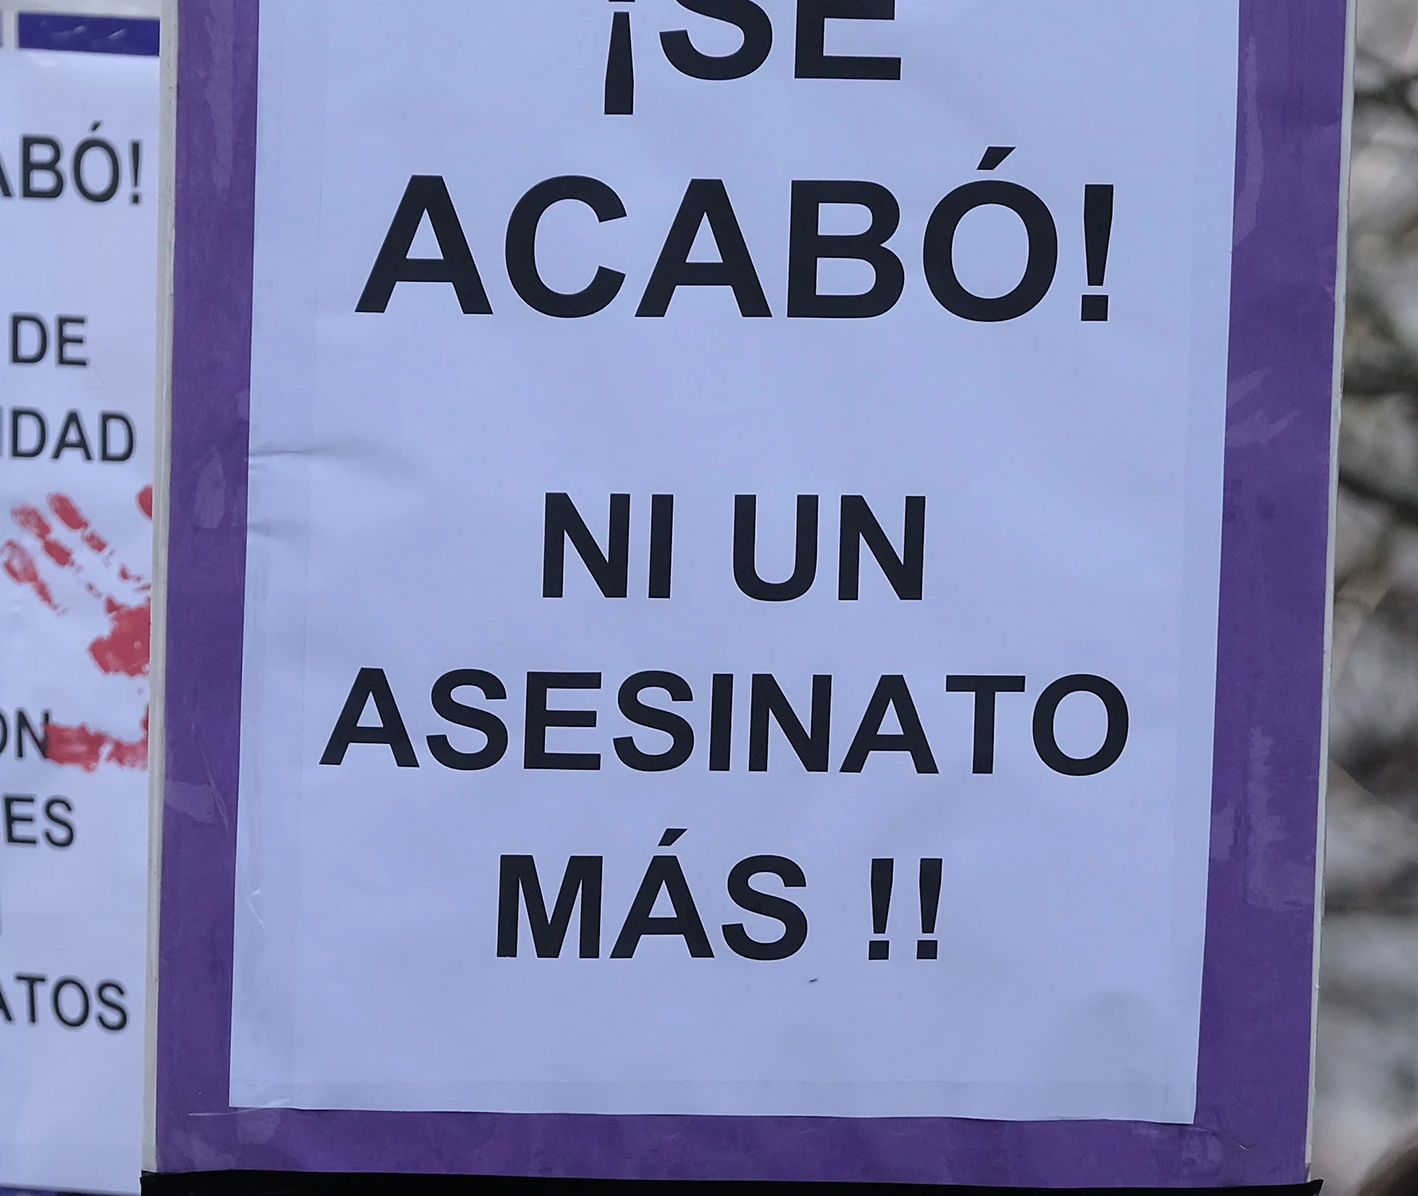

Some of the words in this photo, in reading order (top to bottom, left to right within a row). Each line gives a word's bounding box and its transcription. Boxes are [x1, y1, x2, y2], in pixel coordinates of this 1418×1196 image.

[605, 0, 901, 115] ¡SE
[354, 146, 1114, 323] ACABÓ!
[11, 314, 88, 368] DE
[542, 492, 674, 599] NI
[732, 494, 926, 602] UN
[318, 667, 1129, 777] ASESINATO
[496, 828, 808, 961] MÁS
[868, 857, 943, 961] !!
